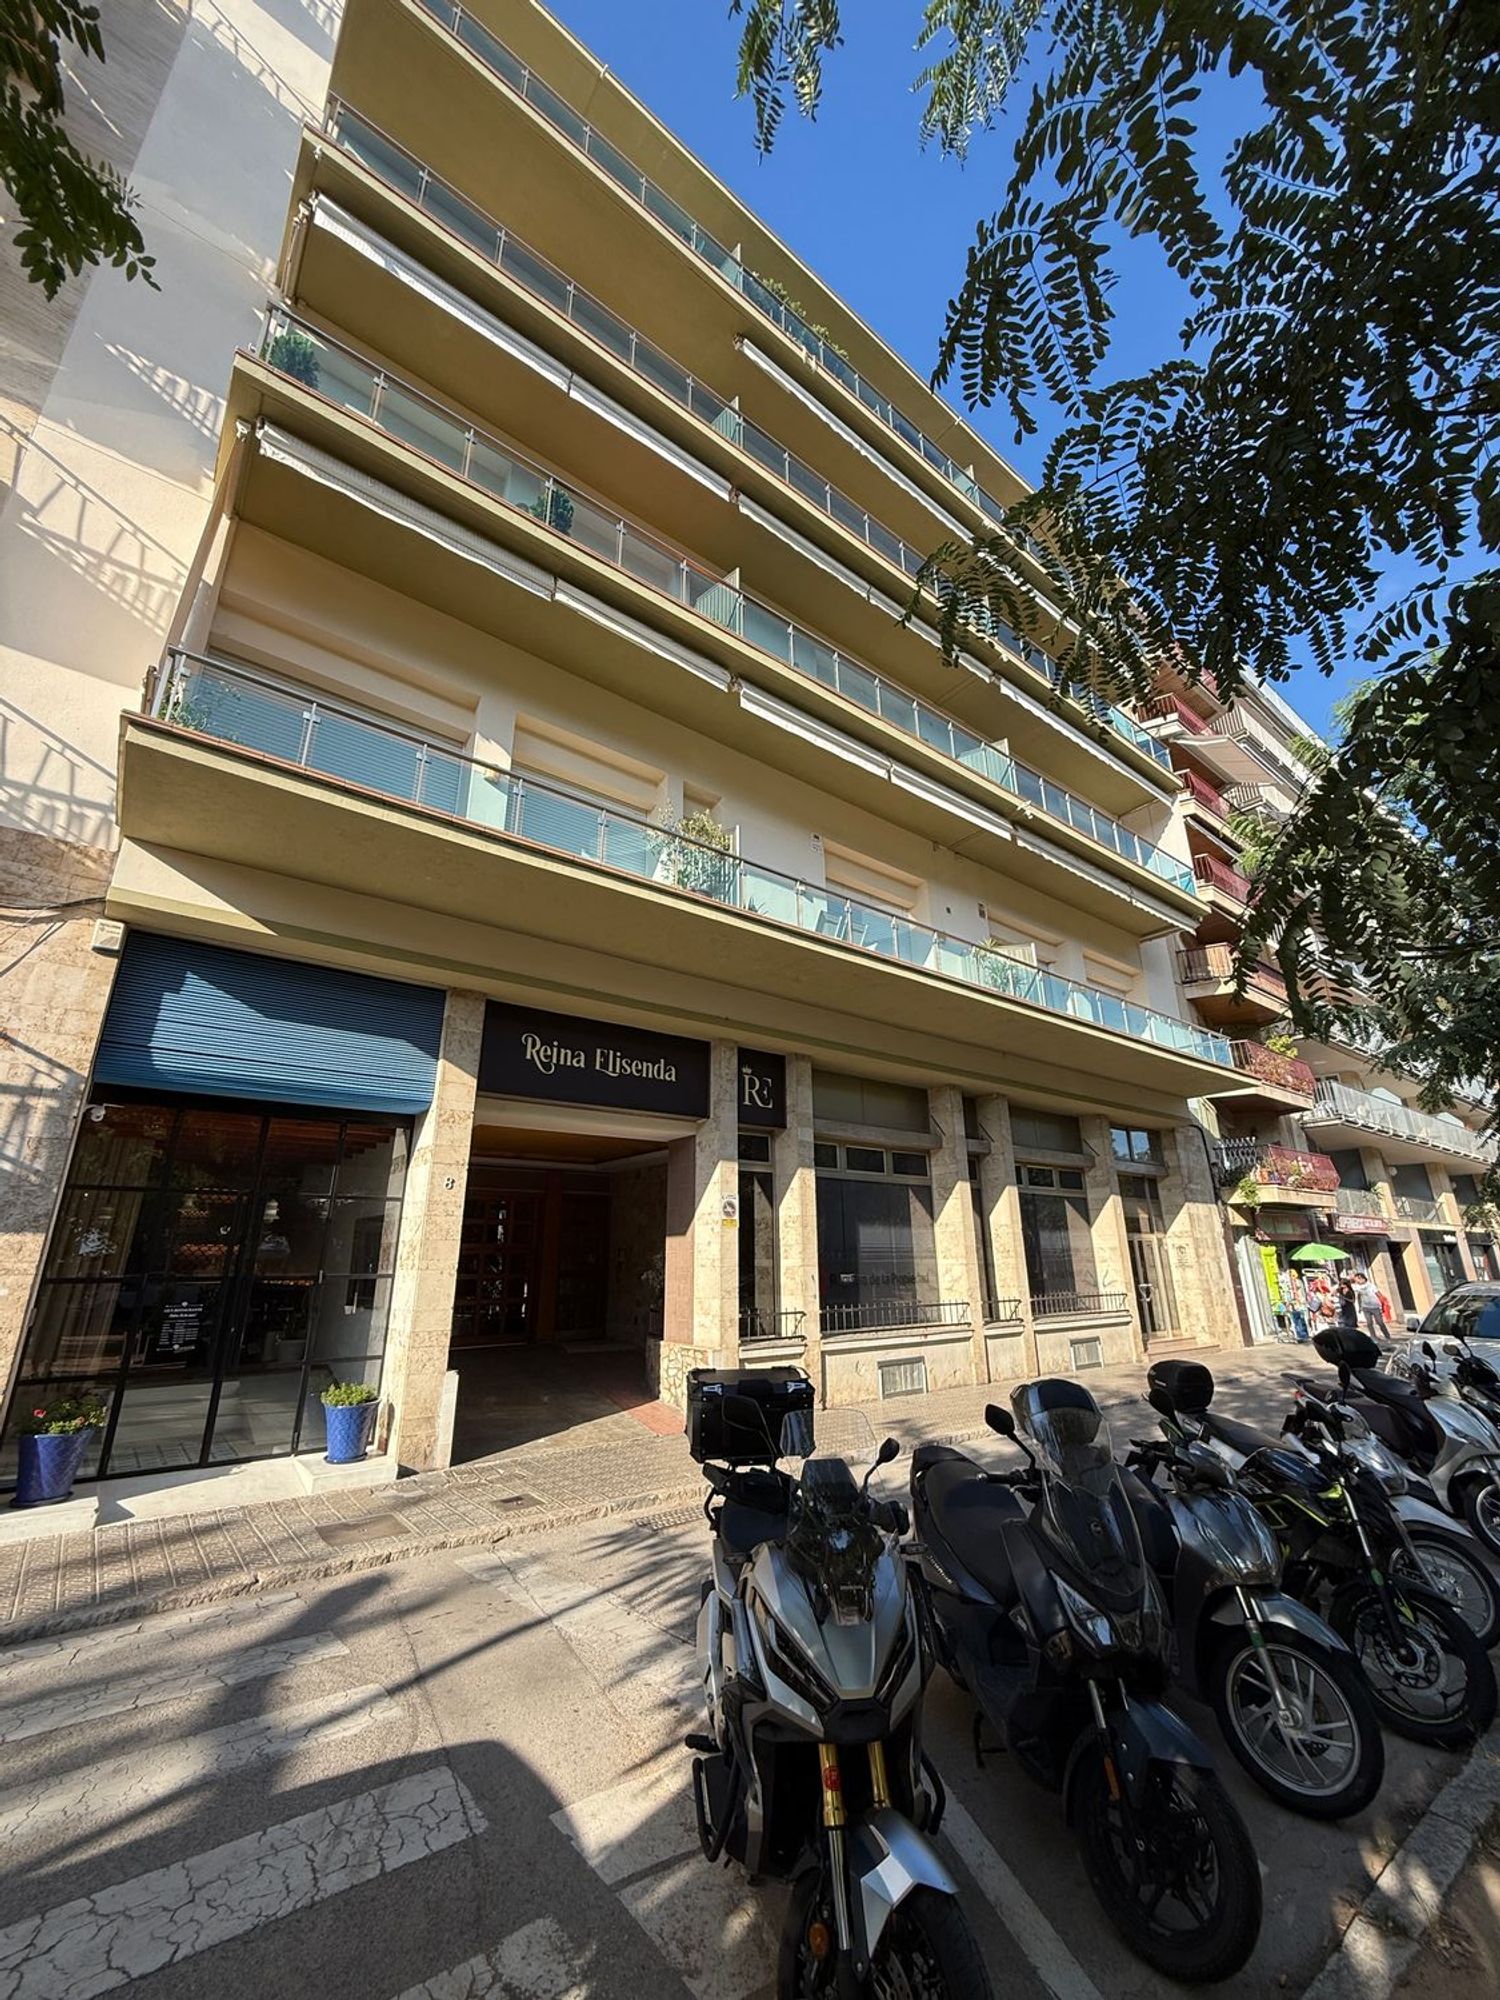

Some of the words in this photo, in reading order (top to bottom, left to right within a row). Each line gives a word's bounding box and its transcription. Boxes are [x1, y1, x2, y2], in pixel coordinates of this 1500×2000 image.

[521, 1033, 586, 1075] Reina
[595, 1048, 677, 1082] Elisenda
[444, 1176, 455, 1190] 8
